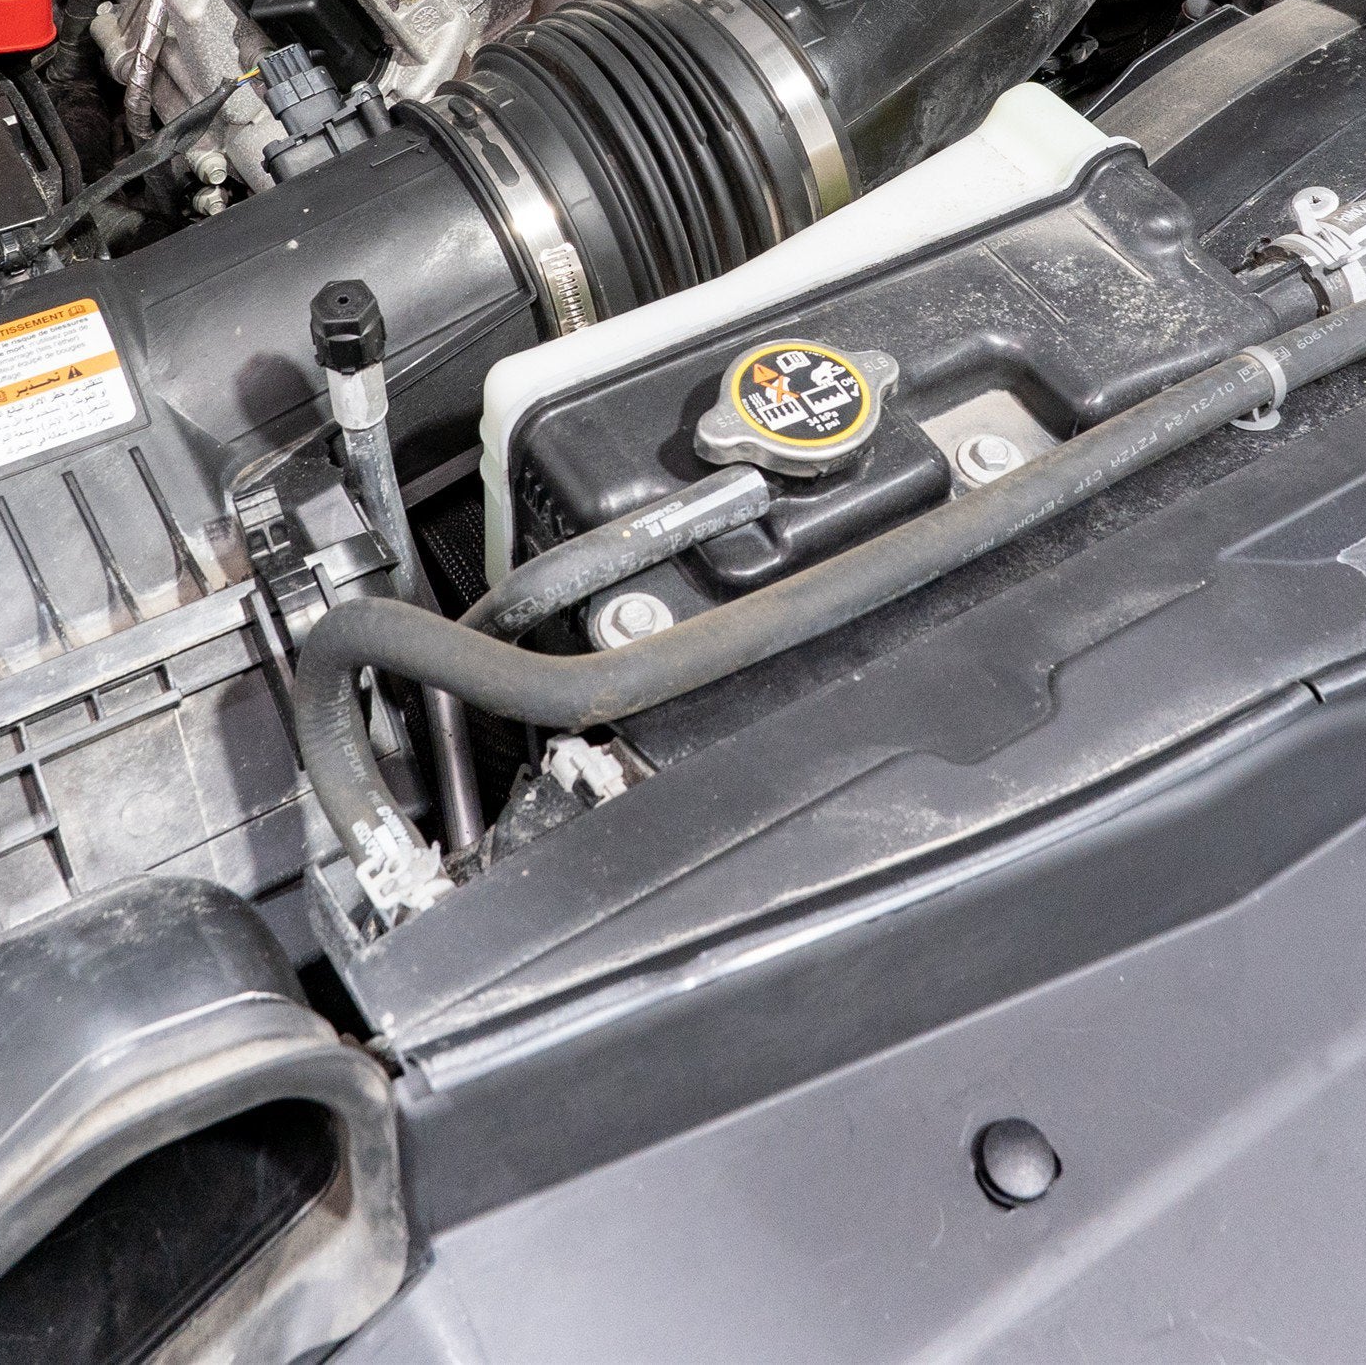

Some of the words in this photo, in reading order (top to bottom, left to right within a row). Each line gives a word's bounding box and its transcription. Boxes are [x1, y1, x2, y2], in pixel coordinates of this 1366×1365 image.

[1296, 315, 1348, 351] 1041909
[839, 374, 858, 388] OK
[1163, 381, 1235, 432] 01/31/24
[805, 415, 820, 427] 34
[818, 408, 839, 422] kPa
[824, 417, 841, 430] psi
